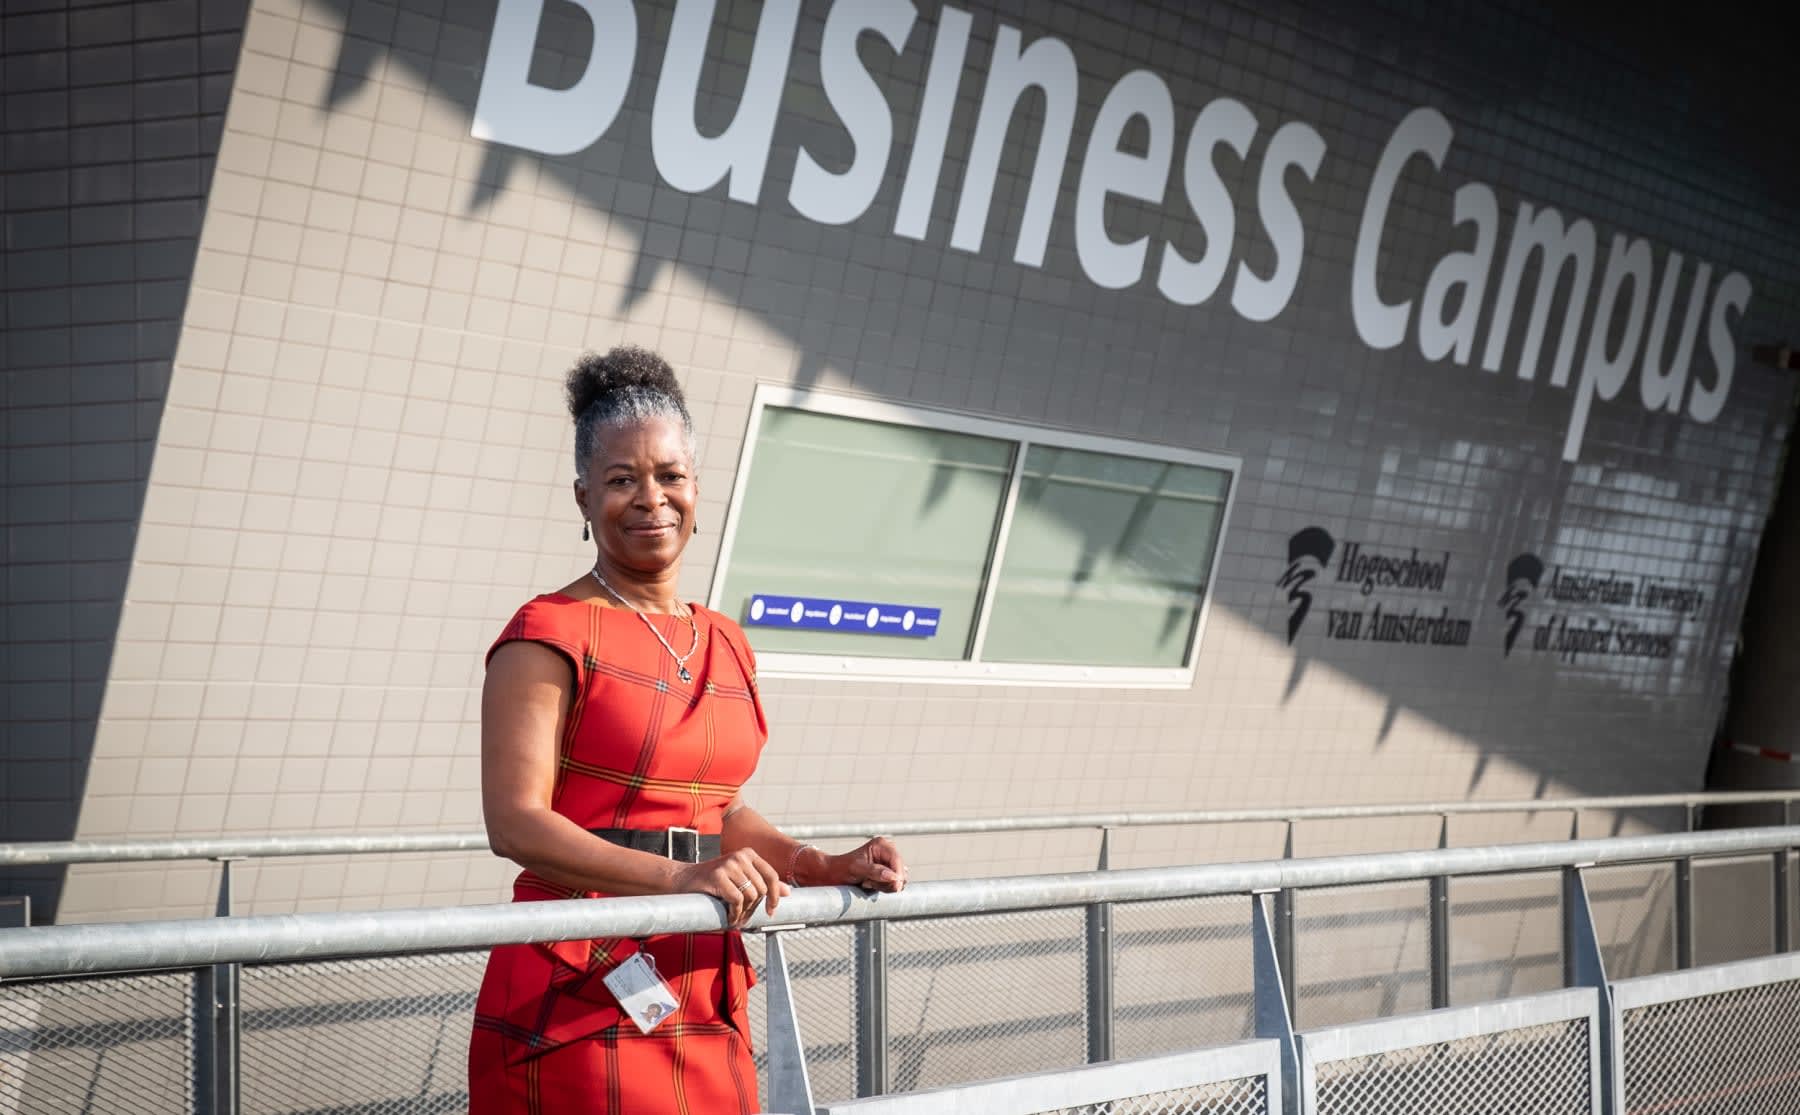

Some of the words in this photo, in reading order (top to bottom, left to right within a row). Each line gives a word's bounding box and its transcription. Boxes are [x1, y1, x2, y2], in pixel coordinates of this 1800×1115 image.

[1351, 107, 1752, 462] Campus
[1336, 542, 1451, 597] Hogeschool
[1543, 565, 1634, 605] Amsterdam
[1327, 609, 1363, 640] van
[1362, 602, 1472, 647] Amsterdam
[1534, 615, 1557, 651] of
[1551, 616, 1616, 664] Applied
[1609, 621, 1672, 659] Sciences
